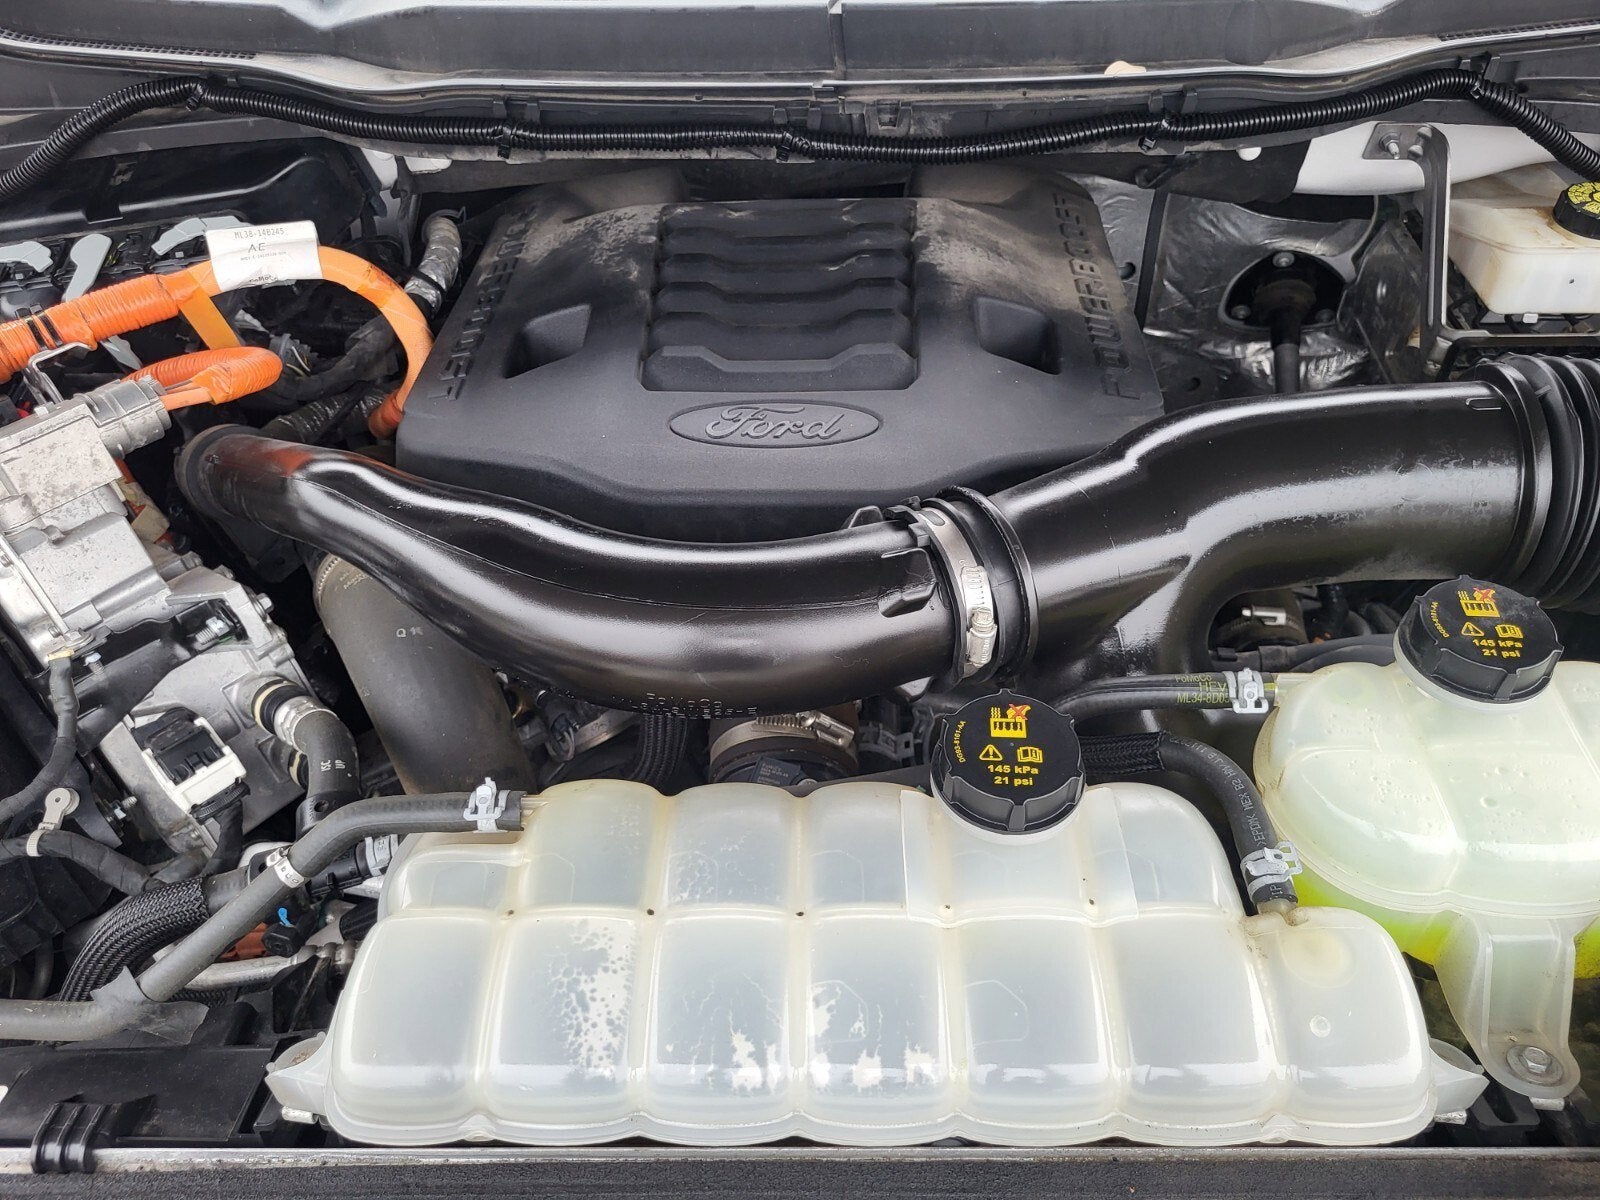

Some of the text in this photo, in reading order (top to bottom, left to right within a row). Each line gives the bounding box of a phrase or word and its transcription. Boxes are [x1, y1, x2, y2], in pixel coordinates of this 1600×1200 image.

[247, 242, 266, 253] AE
[1052, 192, 1141, 400] POWERBOOST
[704, 405, 846, 440] Ford
[1472, 639, 1523, 648] 145 kPa
[1482, 649, 1521, 659] 21 psi
[1175, 674, 1213, 683] FoMoCo
[1198, 681, 1227, 692] HEV
[987, 764, 1039, 775] 145 kPa
[994, 776, 1034, 787] 21 psi
